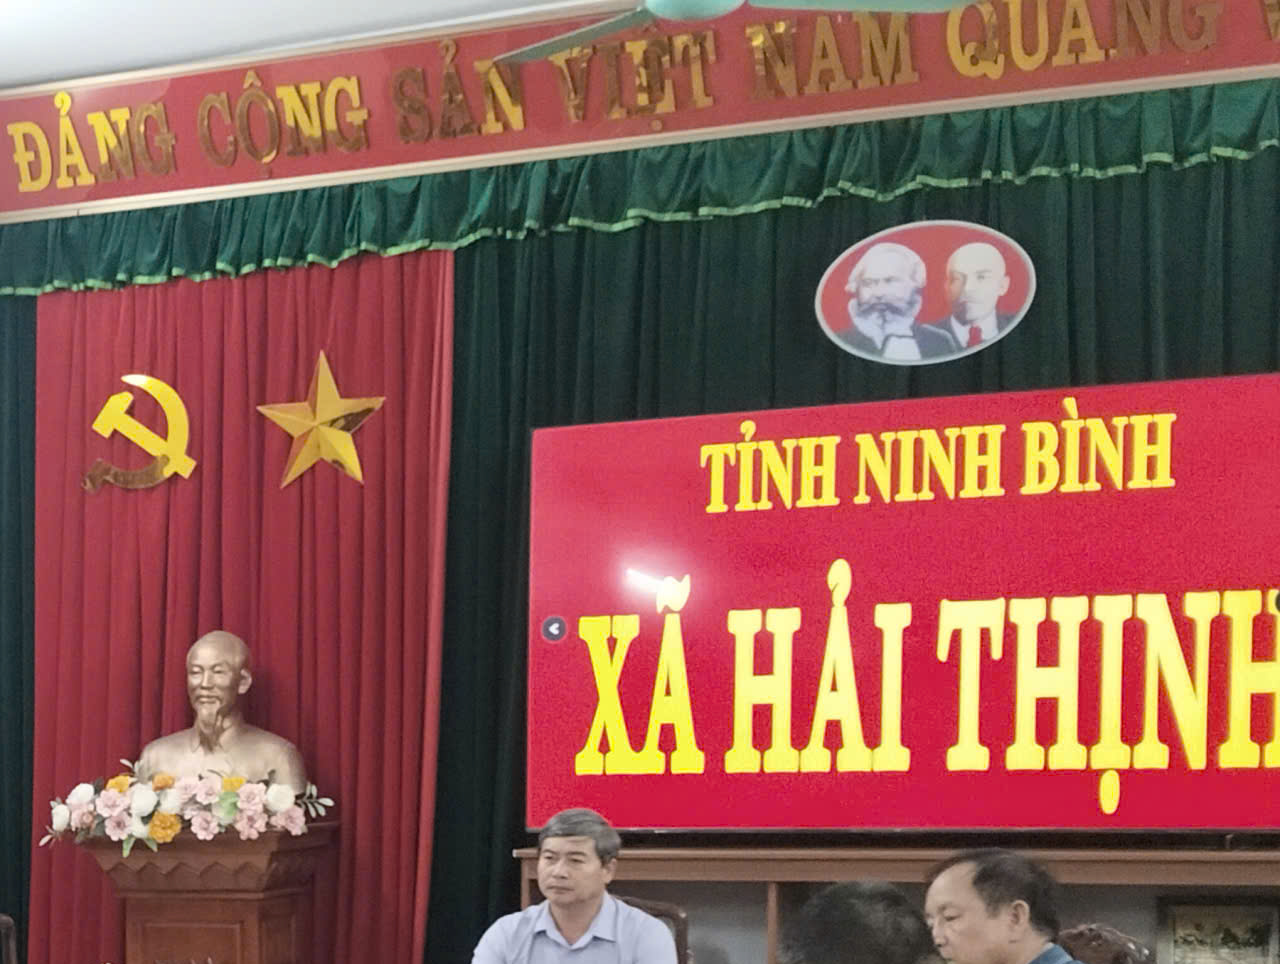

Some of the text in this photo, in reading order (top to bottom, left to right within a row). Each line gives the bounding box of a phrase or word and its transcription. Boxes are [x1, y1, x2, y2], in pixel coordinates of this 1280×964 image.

[7, 91, 176, 192] ĐẢNG
[196, 69, 369, 178] CỘNG
[392, 38, 525, 145] SẢN
[547, 19, 717, 131] VIỆT
[745, 6, 920, 100] NAM
[946, 0, 1219, 80] QUANG
[699, 397, 1177, 514] TỈNH NINH BÌNH
[574, 558, 1280, 815] XÃ HẢI THỊNH
